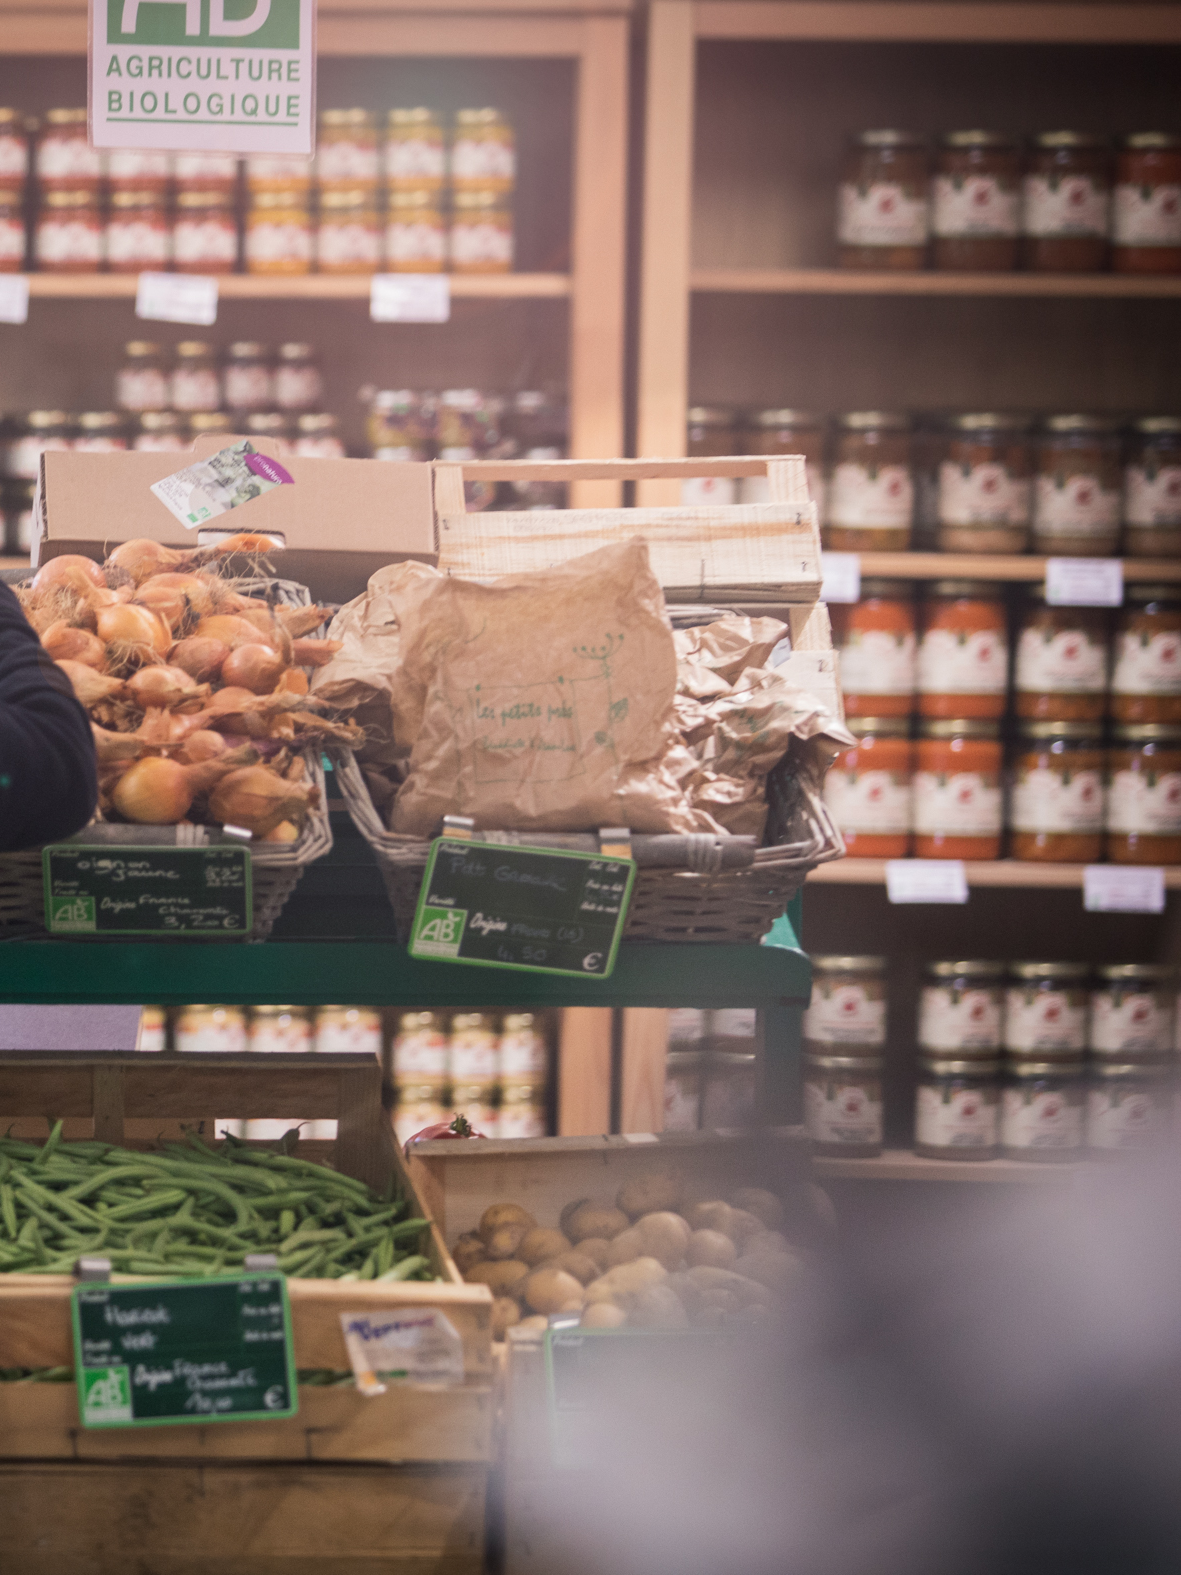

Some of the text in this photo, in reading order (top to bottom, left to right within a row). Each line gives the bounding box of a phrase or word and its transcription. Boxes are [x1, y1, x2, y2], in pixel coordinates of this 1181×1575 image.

[106, 54, 301, 81] AGRICULTURE
[107, 90, 301, 117] BIOLOGIQUE
[55, 904, 88, 921] AB
[469, 912, 508, 936] Origine
[420, 918, 455, 941] AB
[582, 952, 603, 971] €
